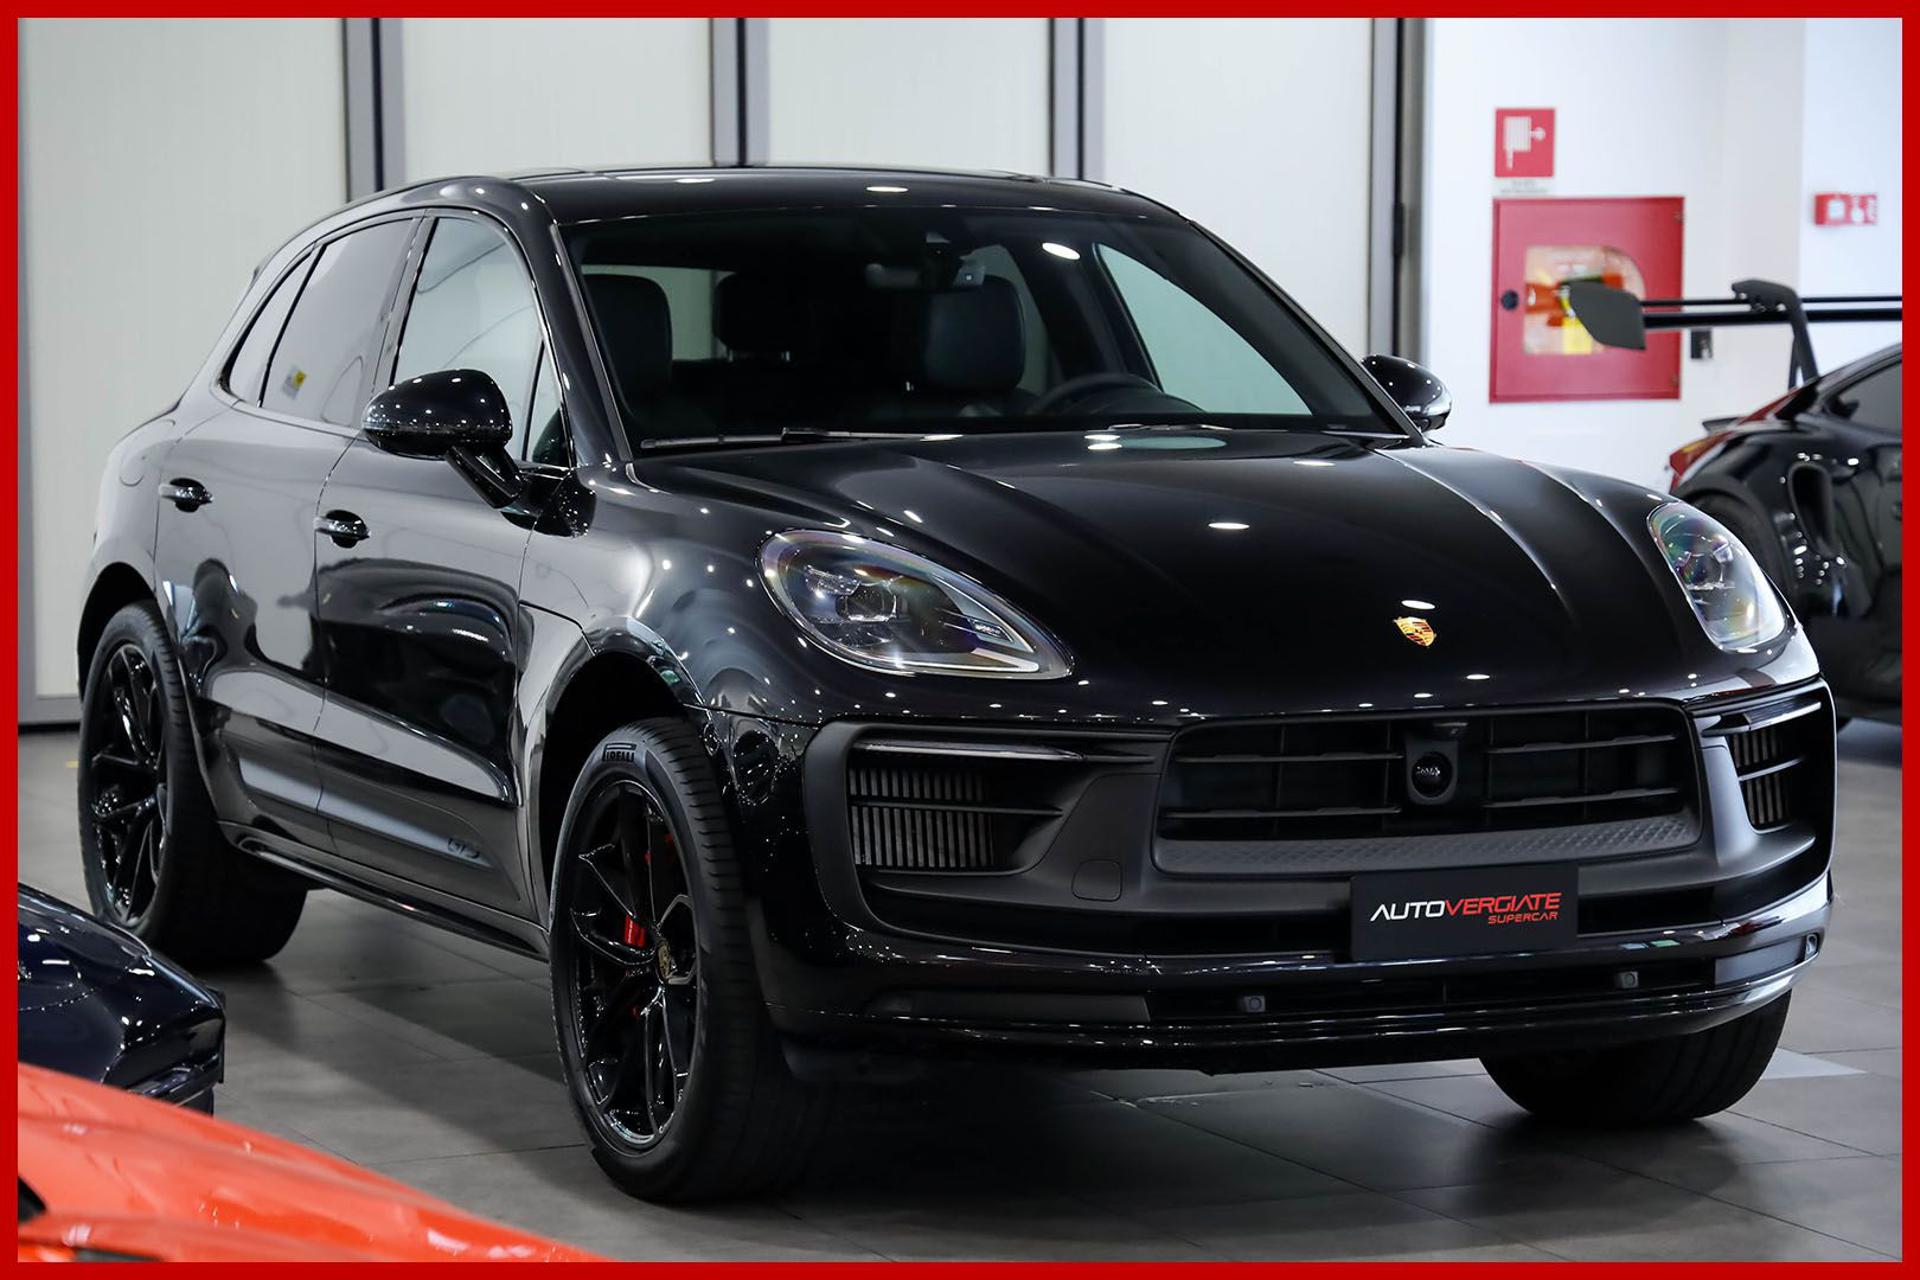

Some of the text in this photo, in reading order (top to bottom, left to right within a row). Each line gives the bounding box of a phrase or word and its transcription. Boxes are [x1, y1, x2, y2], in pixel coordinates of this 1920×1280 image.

[602, 742, 637, 762] PIRELLI
[1370, 892, 1562, 922] AUTOVERGIATE
[1487, 911, 1559, 925] SUPERCAR
